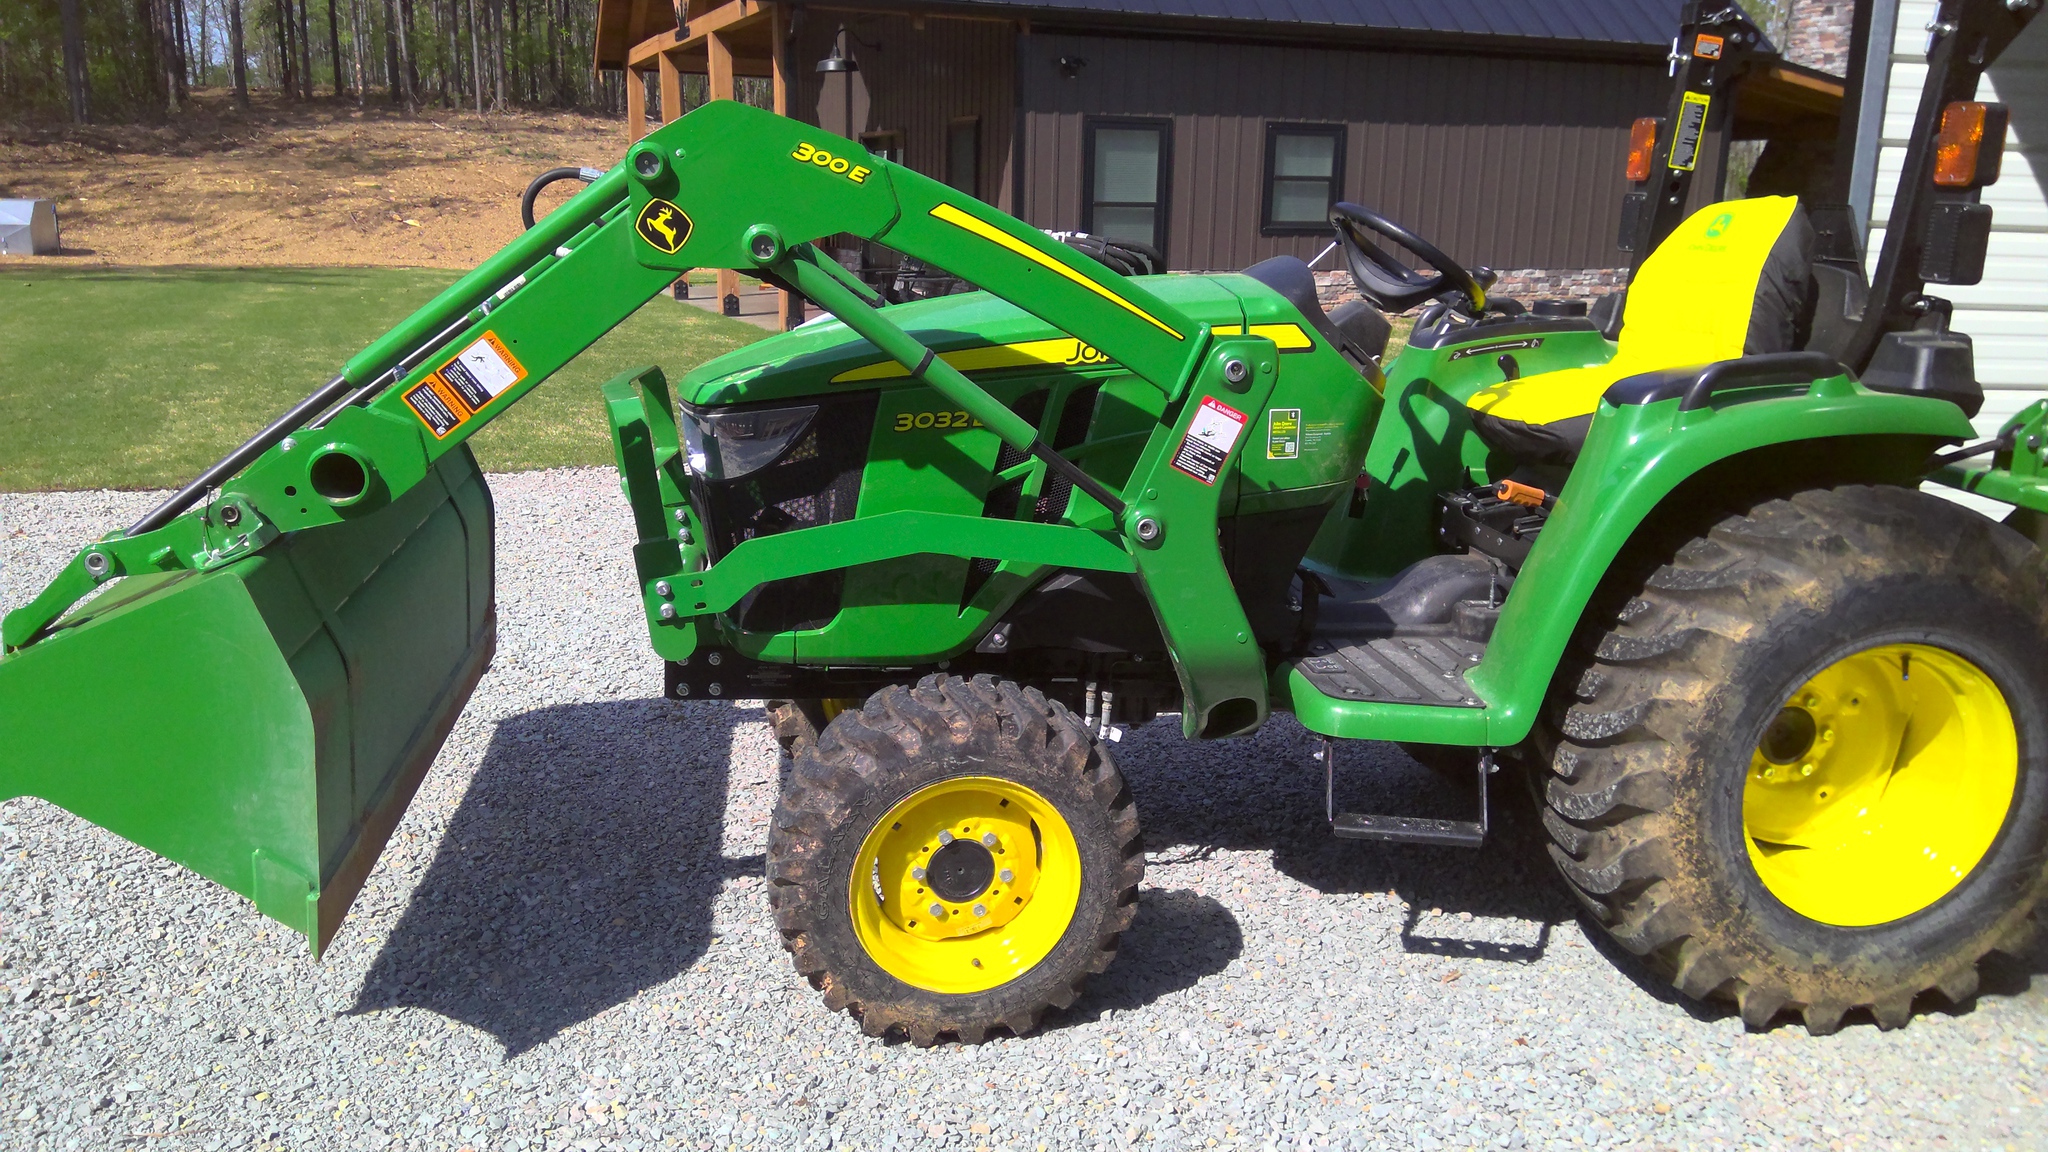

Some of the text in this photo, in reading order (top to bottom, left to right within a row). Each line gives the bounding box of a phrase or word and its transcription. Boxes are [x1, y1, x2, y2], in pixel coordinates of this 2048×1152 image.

[494, 343, 521, 374] WARNING
[1065, 341, 1105, 362] JO
[437, 387, 464, 417] WARNING
[1216, 404, 1242, 421] DANGER
